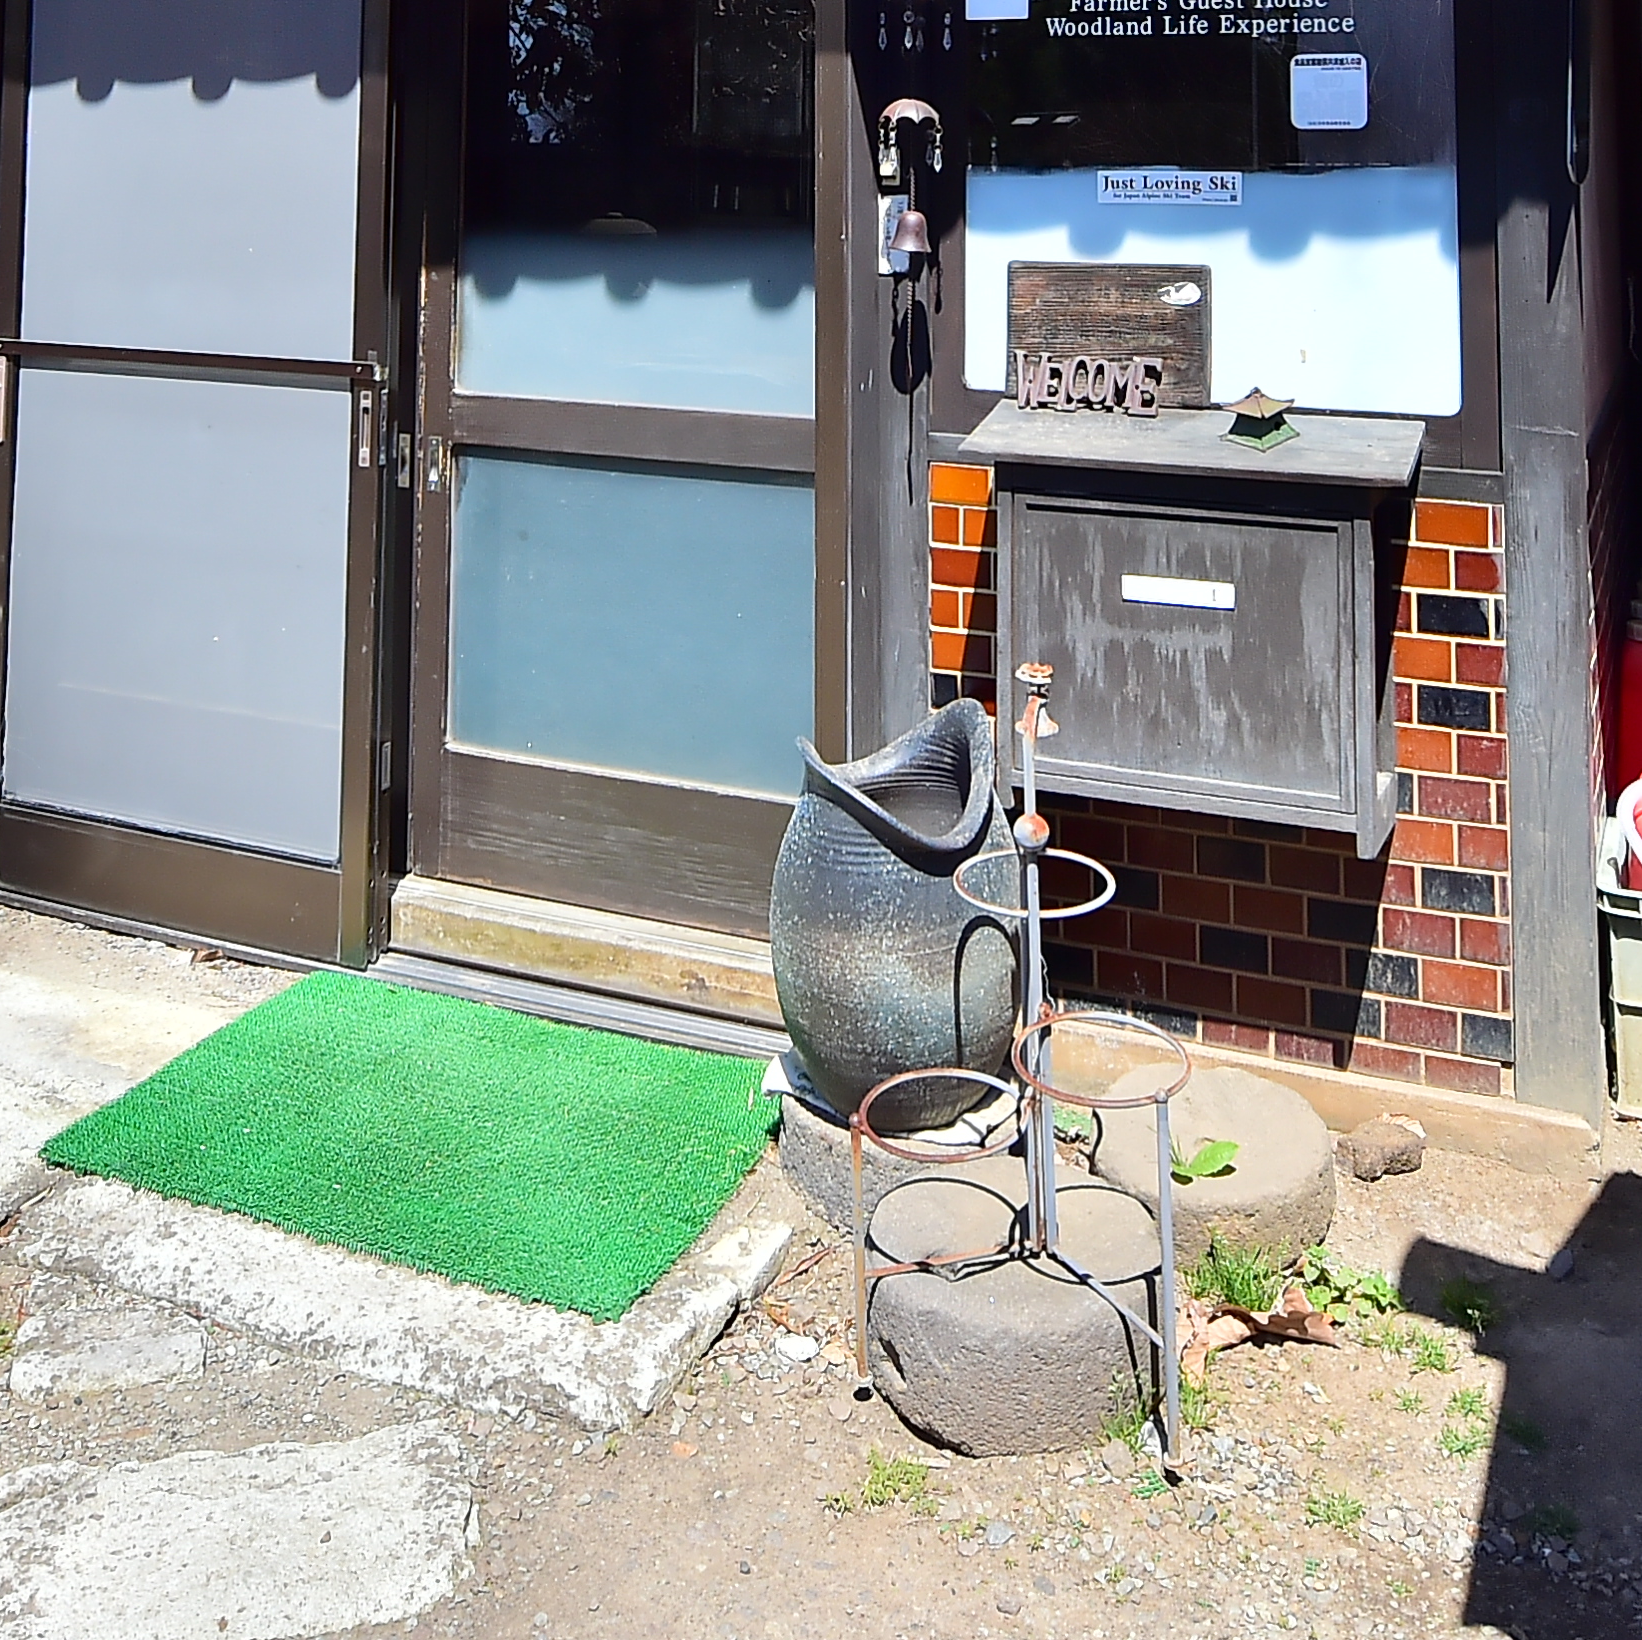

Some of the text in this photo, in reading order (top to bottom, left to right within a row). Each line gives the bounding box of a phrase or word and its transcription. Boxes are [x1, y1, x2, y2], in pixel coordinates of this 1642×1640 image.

[1045, 13, 1355, 38] Woodland Life Experience
[1102, 175, 1237, 195] Just Loving Ski
[1013, 350, 1163, 417] WELCOME
